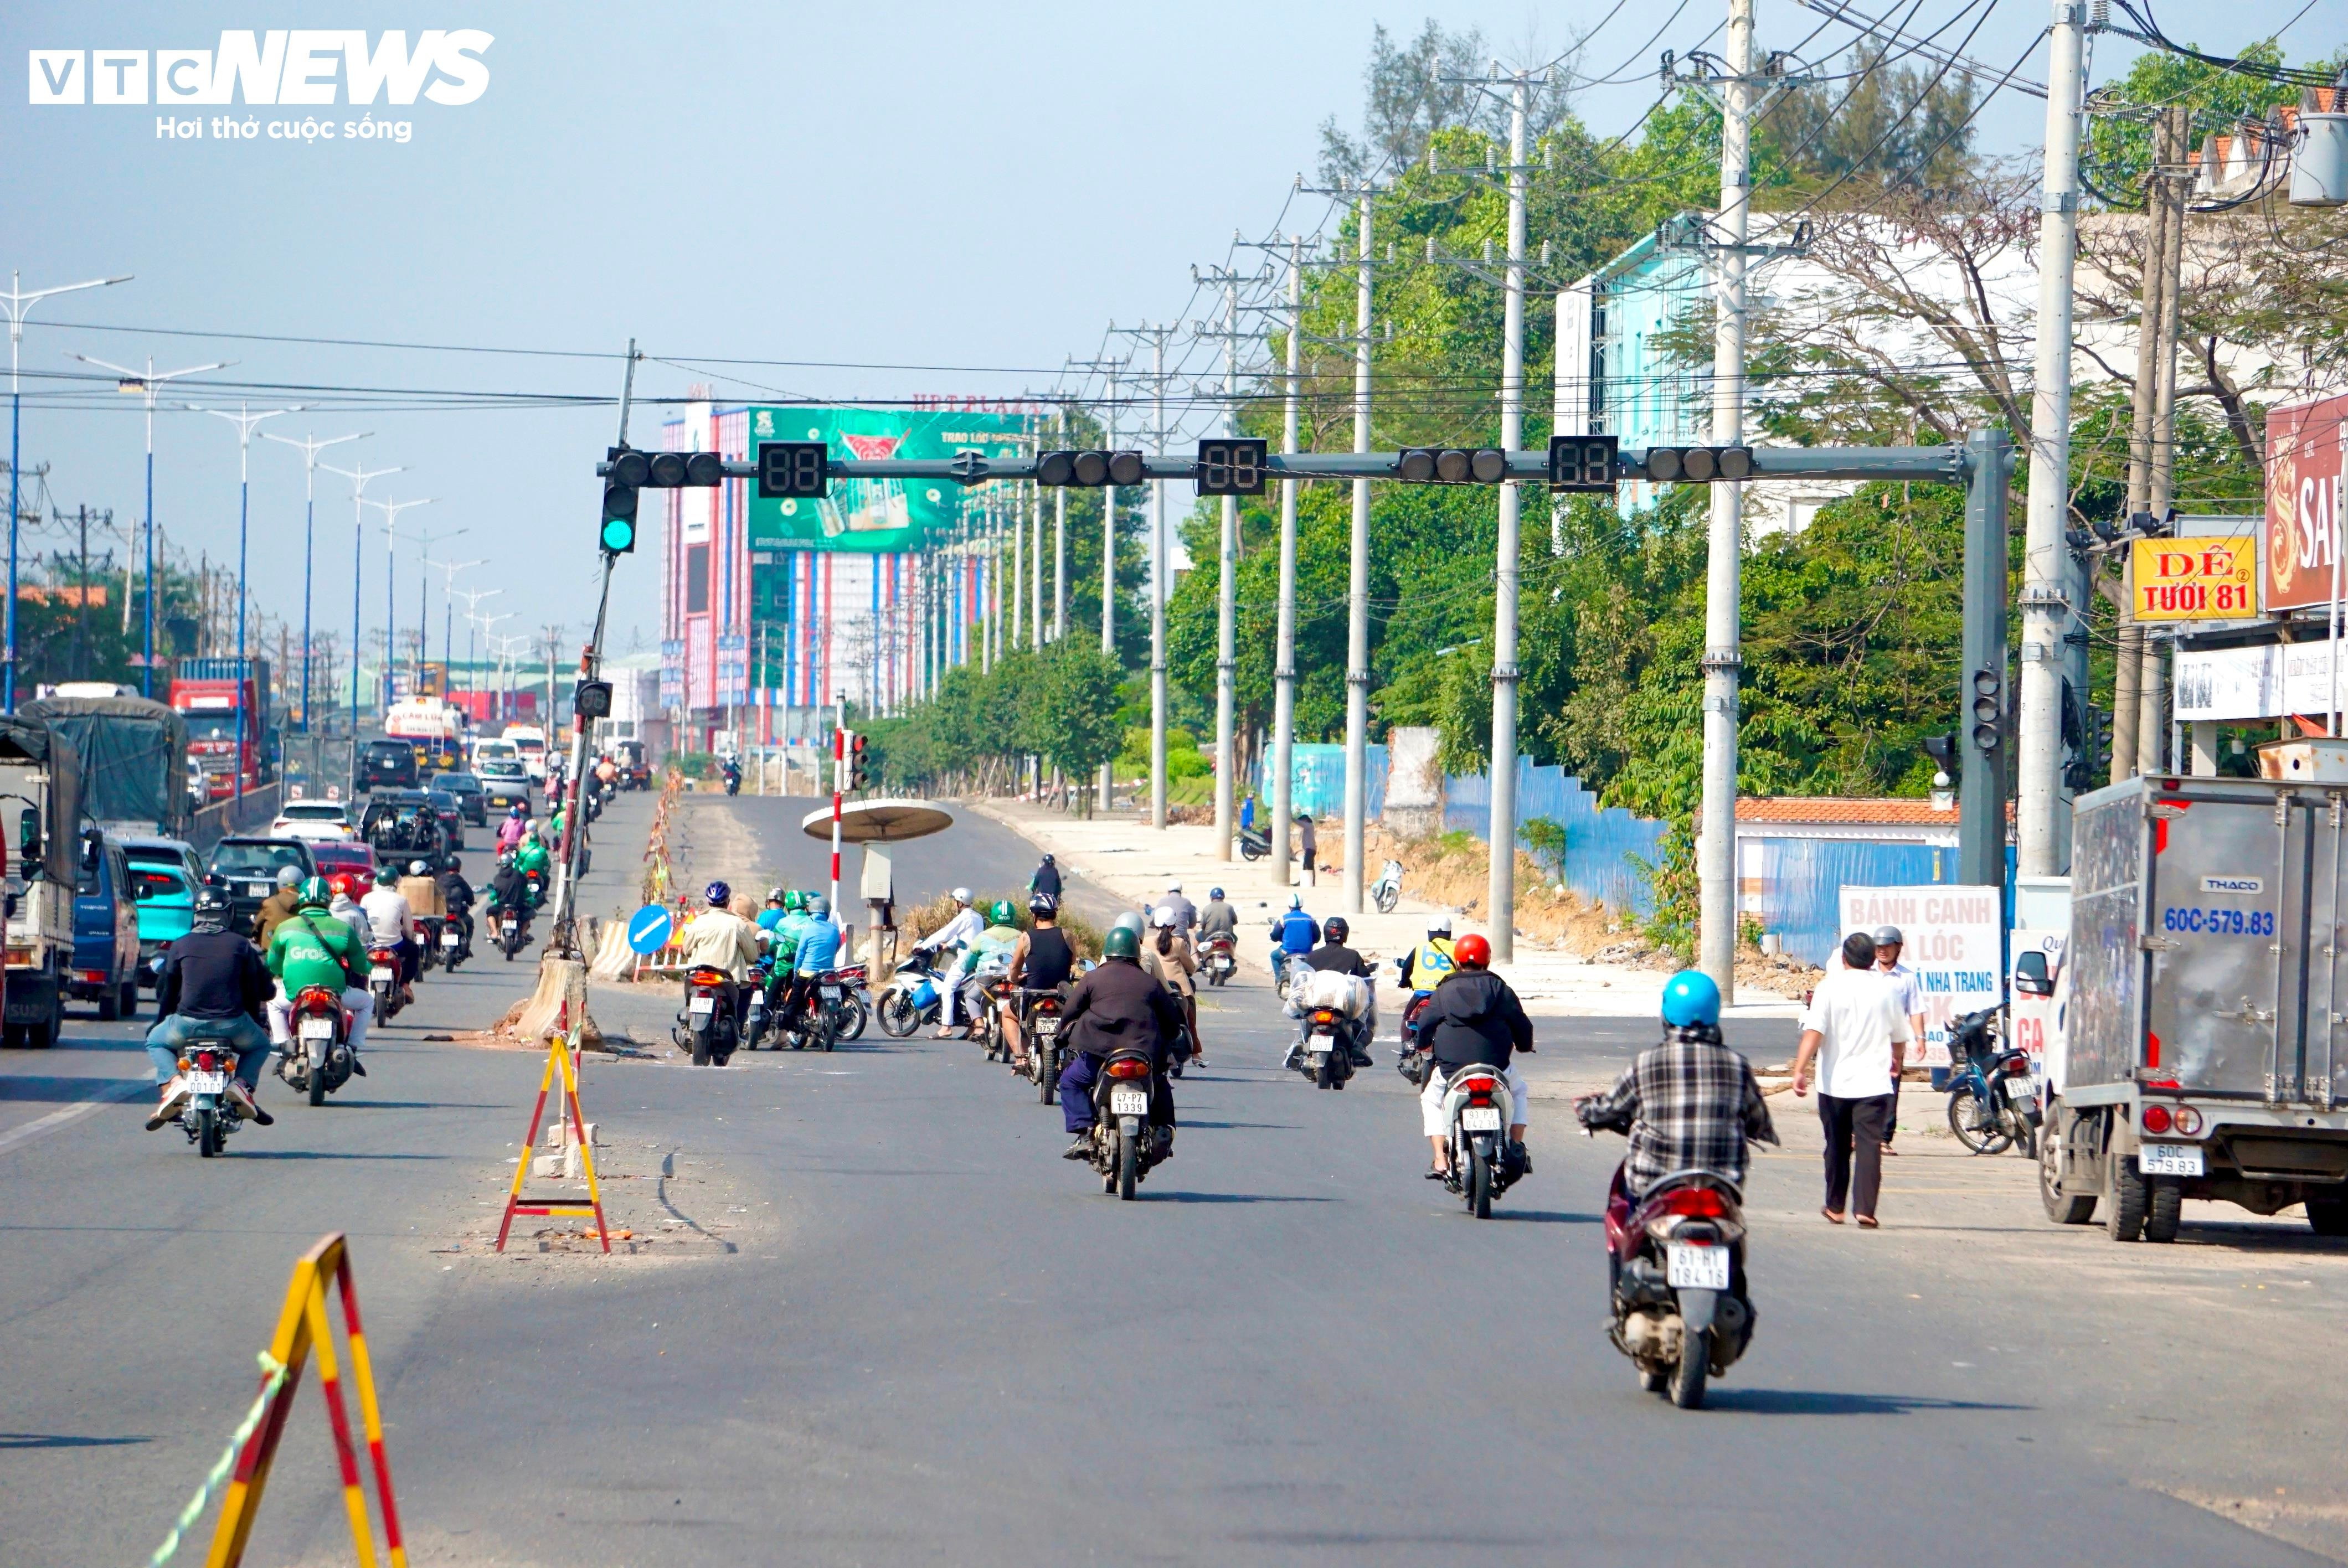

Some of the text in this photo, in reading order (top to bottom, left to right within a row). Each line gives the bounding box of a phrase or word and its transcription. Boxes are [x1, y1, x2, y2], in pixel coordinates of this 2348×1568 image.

[2155, 545, 2234, 577] DÊ
[2143, 582, 2247, 612] TƯƠI 81
[2207, 879, 2259, 890] THACO
[1850, 893, 1991, 925] BÁNH CANH
[1919, 929, 1964, 961] LÓC
[2042, 935, 2063, 952] Qu
[1422, 945, 1451, 971] be
[1926, 972, 1951, 992] NHA
[1954, 971, 1994, 992] TRANG
[1117, 1094, 1142, 1103] 47-P7
[1118, 1103, 1142, 1112] 1339
[2158, 1146, 2184, 1158] 60C
[2148, 1159, 2196, 1173] 579.83
